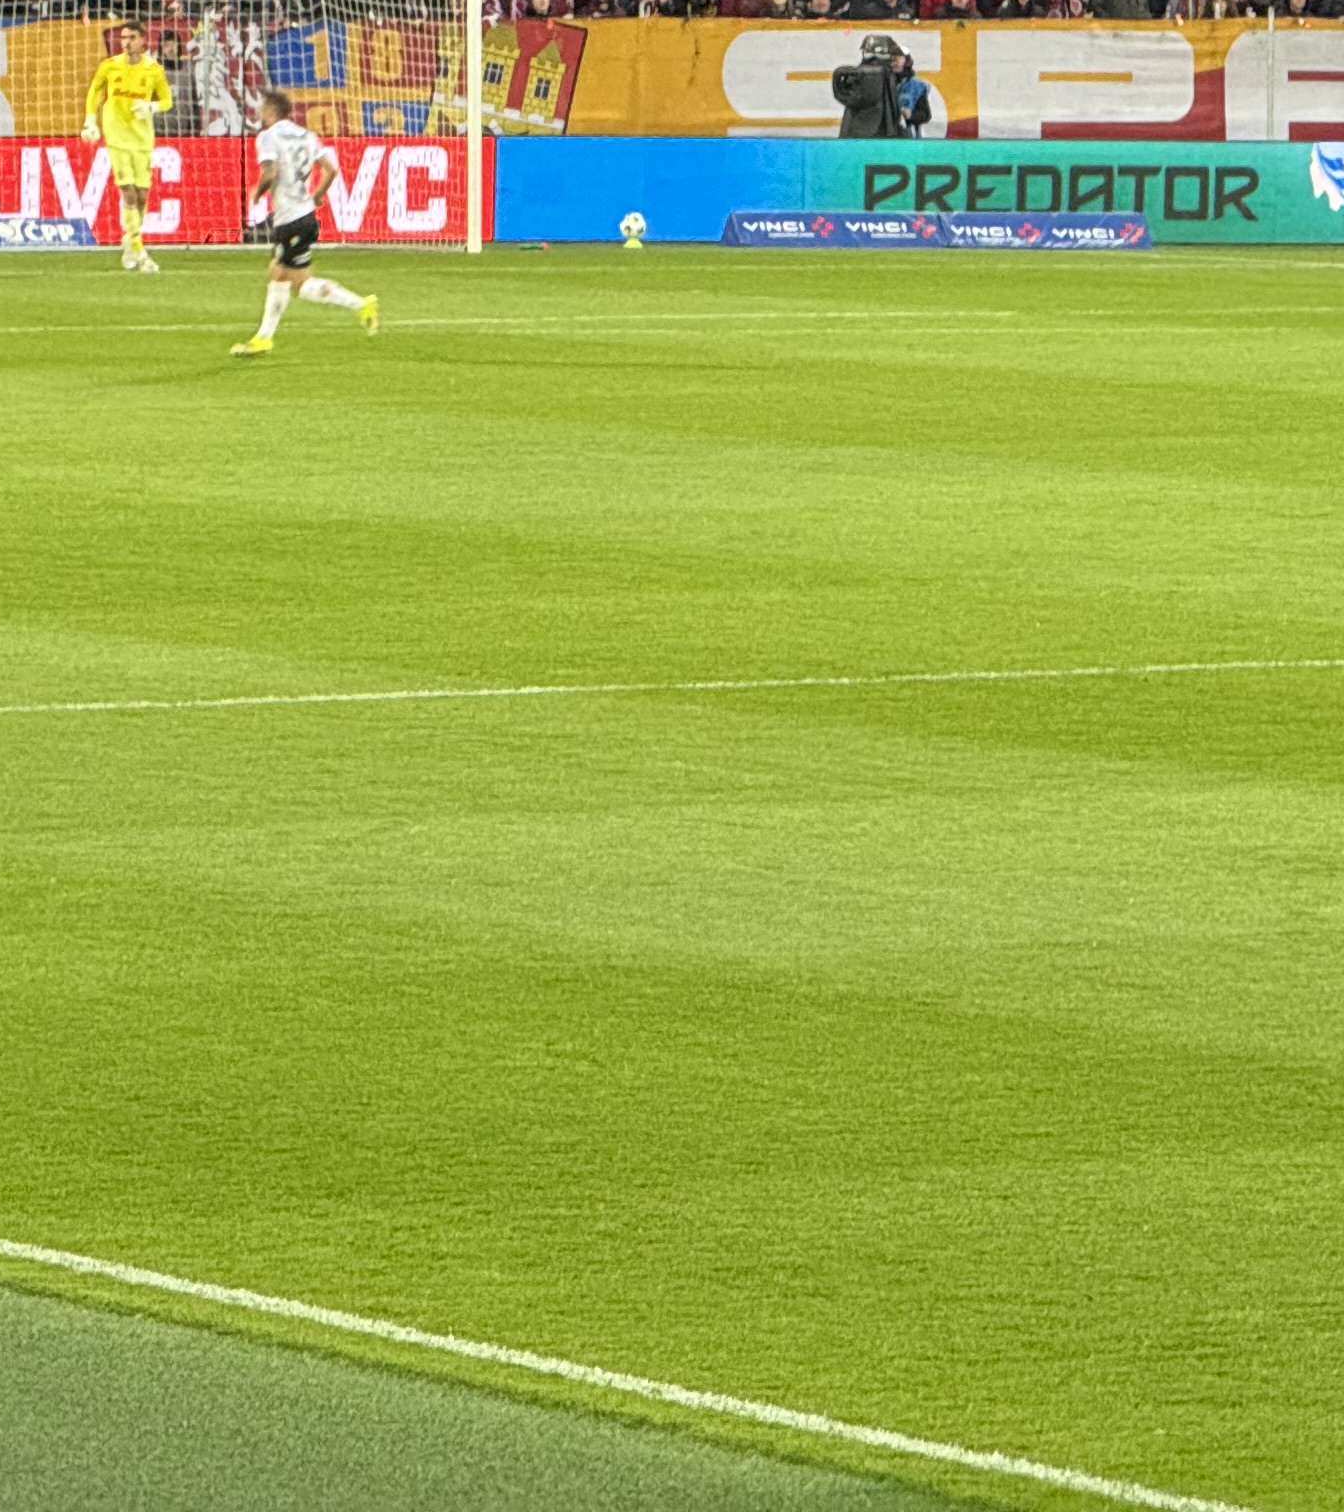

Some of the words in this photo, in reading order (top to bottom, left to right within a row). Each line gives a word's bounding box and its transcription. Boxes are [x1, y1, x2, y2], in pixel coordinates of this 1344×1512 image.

[248, 145, 448, 233] VC
[864, 165, 1260, 222] PREDATOR
[743, 221, 806, 233] VINCI
[845, 221, 907, 233] VINCI
[1052, 226, 1115, 239] VINCI
